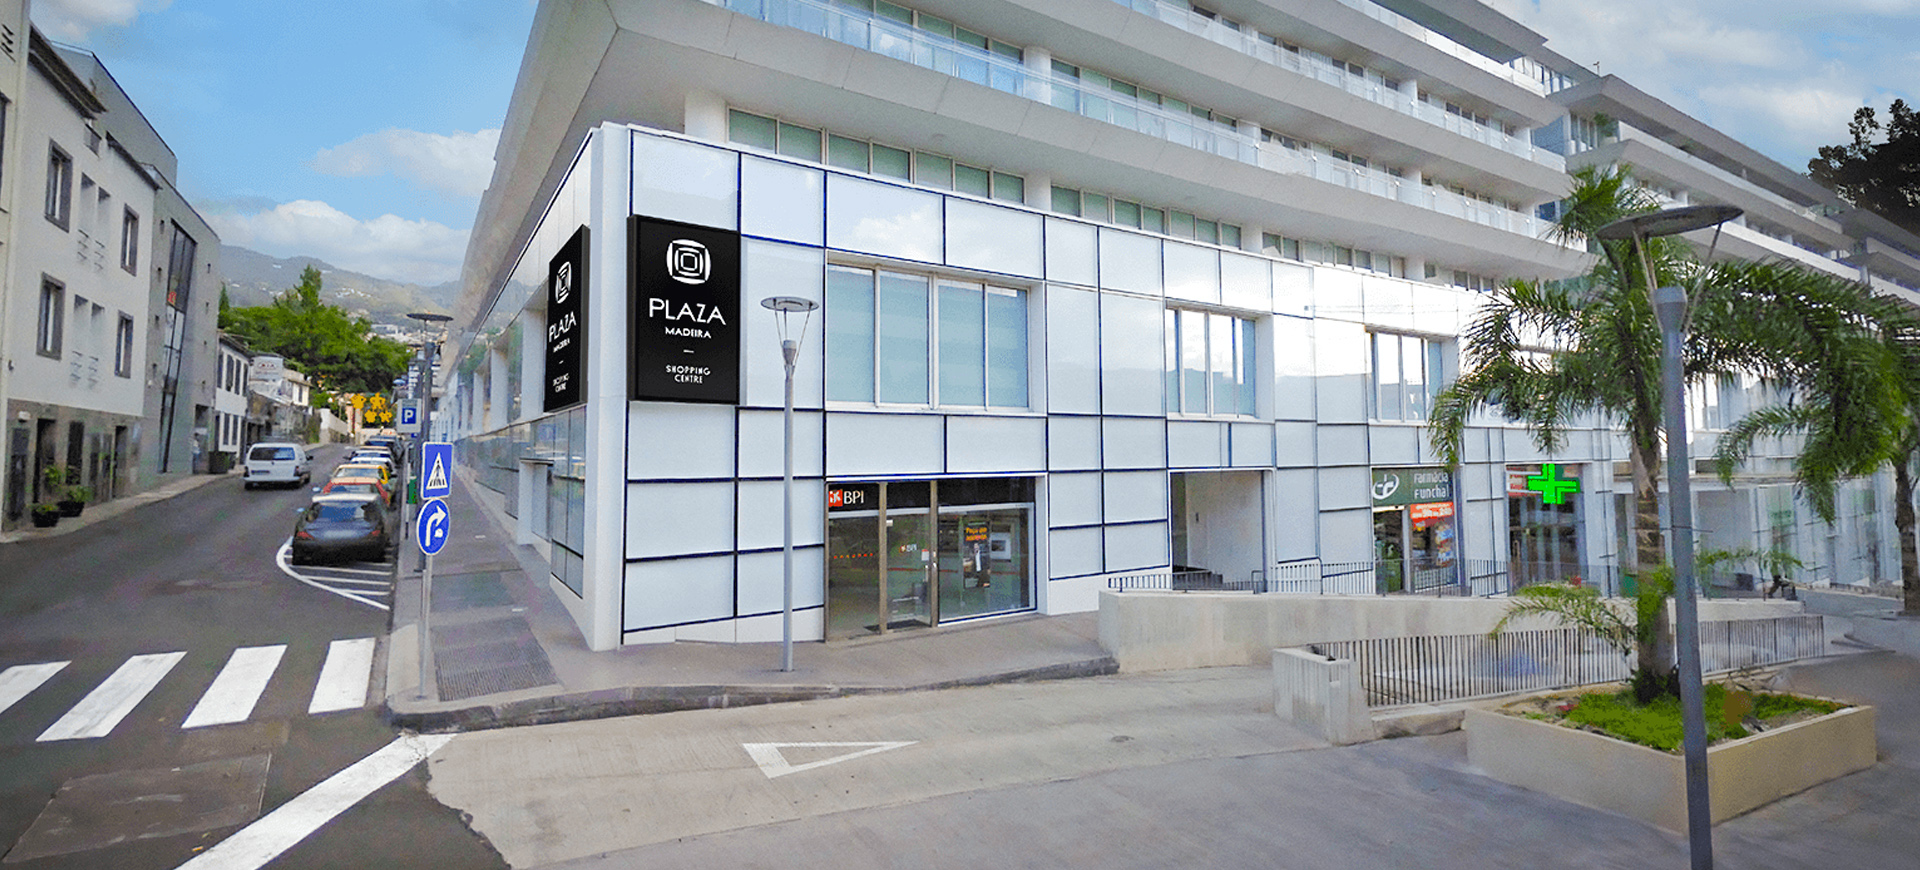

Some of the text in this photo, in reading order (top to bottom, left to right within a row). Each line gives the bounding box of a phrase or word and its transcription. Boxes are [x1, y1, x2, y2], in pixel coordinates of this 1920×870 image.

[648, 297, 727, 326] PLAZA
[548, 310, 577, 343] PLAZA
[664, 326, 712, 339] MADEIRA
[665, 364, 711, 376] SHOPPING
[674, 374, 703, 384] CENTRE
[403, 409, 415, 423] P
[843, 490, 865, 505] BPI
